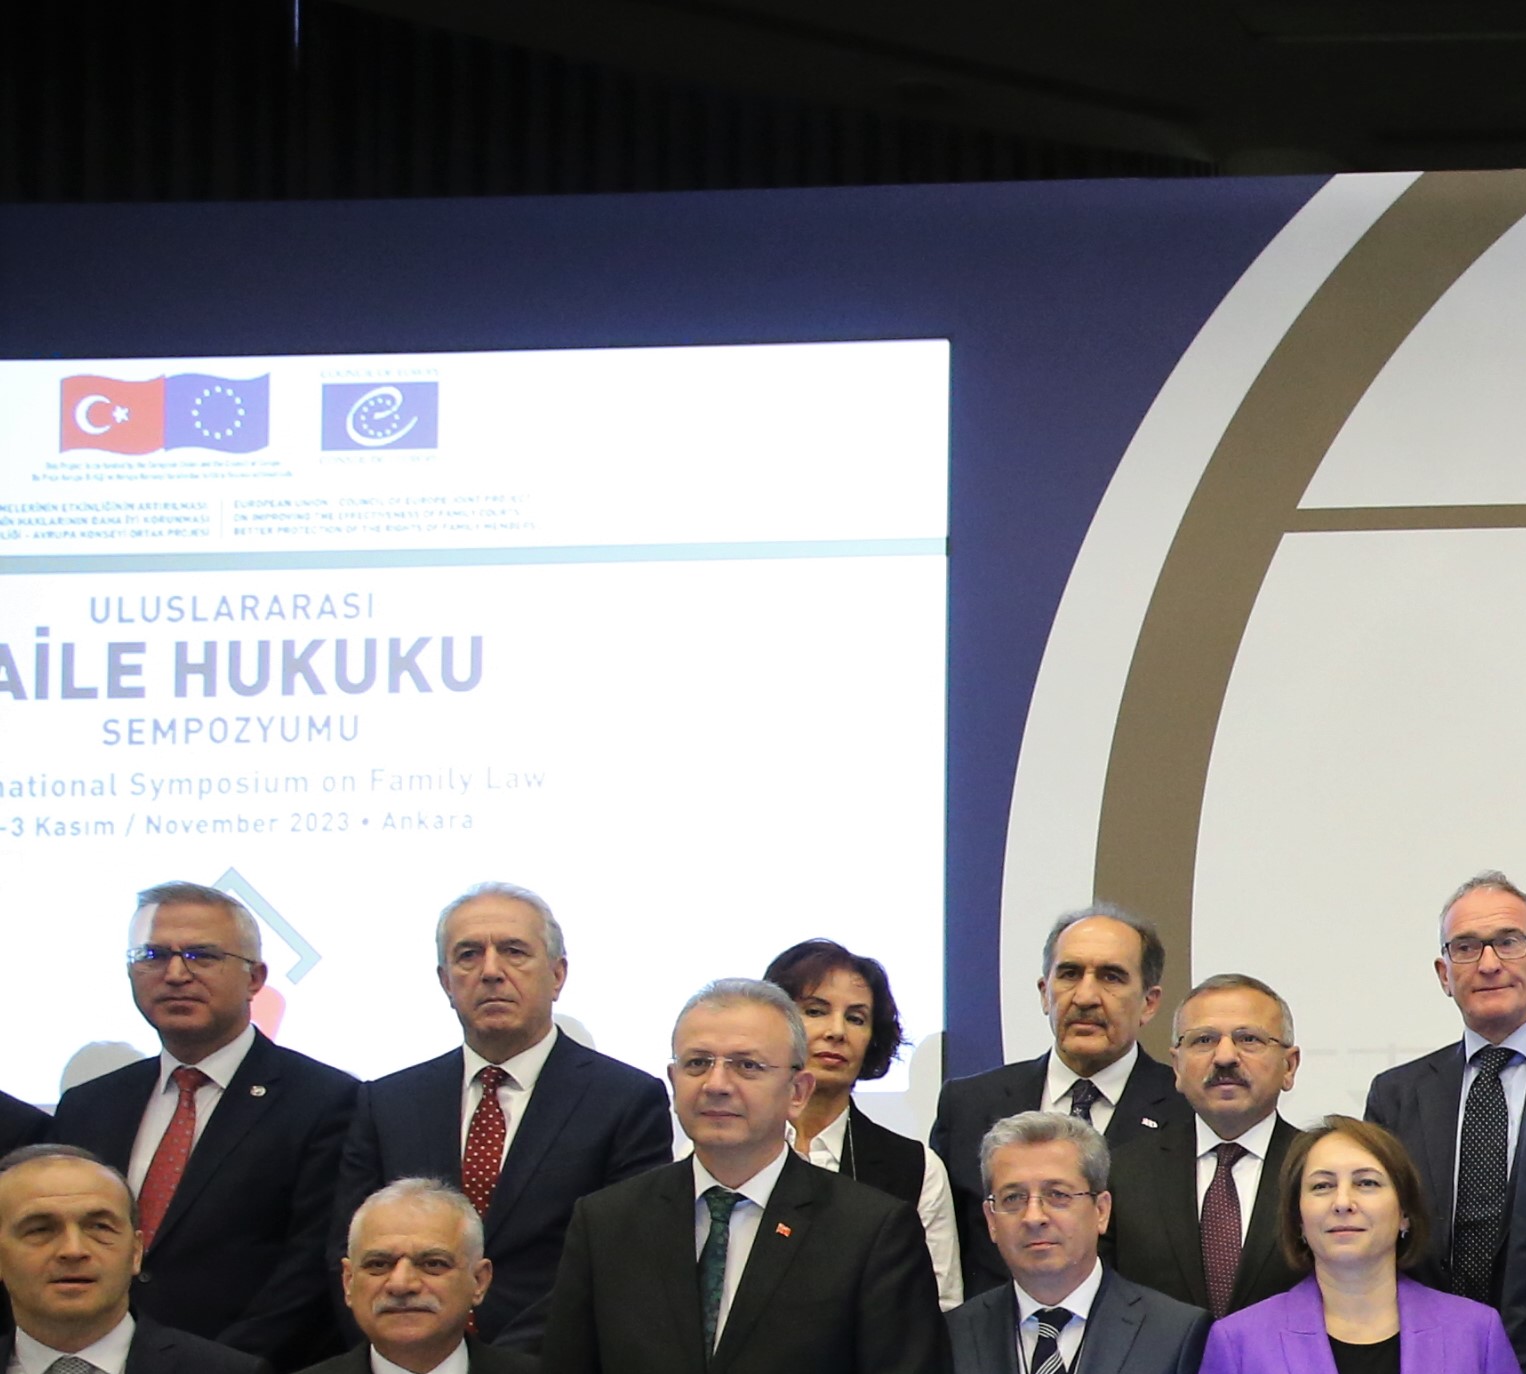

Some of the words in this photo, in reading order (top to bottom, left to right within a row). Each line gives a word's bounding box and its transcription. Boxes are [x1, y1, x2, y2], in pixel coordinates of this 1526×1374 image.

[90, 592, 372, 624] ULUSLARARASI
[174, 636, 482, 697] HUKUKU
[103, 715, 357, 746] SEMPOZYUMU
[130, 771, 308, 801] Symposium
[323, 775, 355, 793] on
[371, 768, 472, 795] Family
[487, 767, 544, 789] Law
[35, 816, 115, 837] Kasım
[145, 814, 278, 835] November
[291, 812, 348, 832] 2023
[383, 811, 472, 830] Ankara
